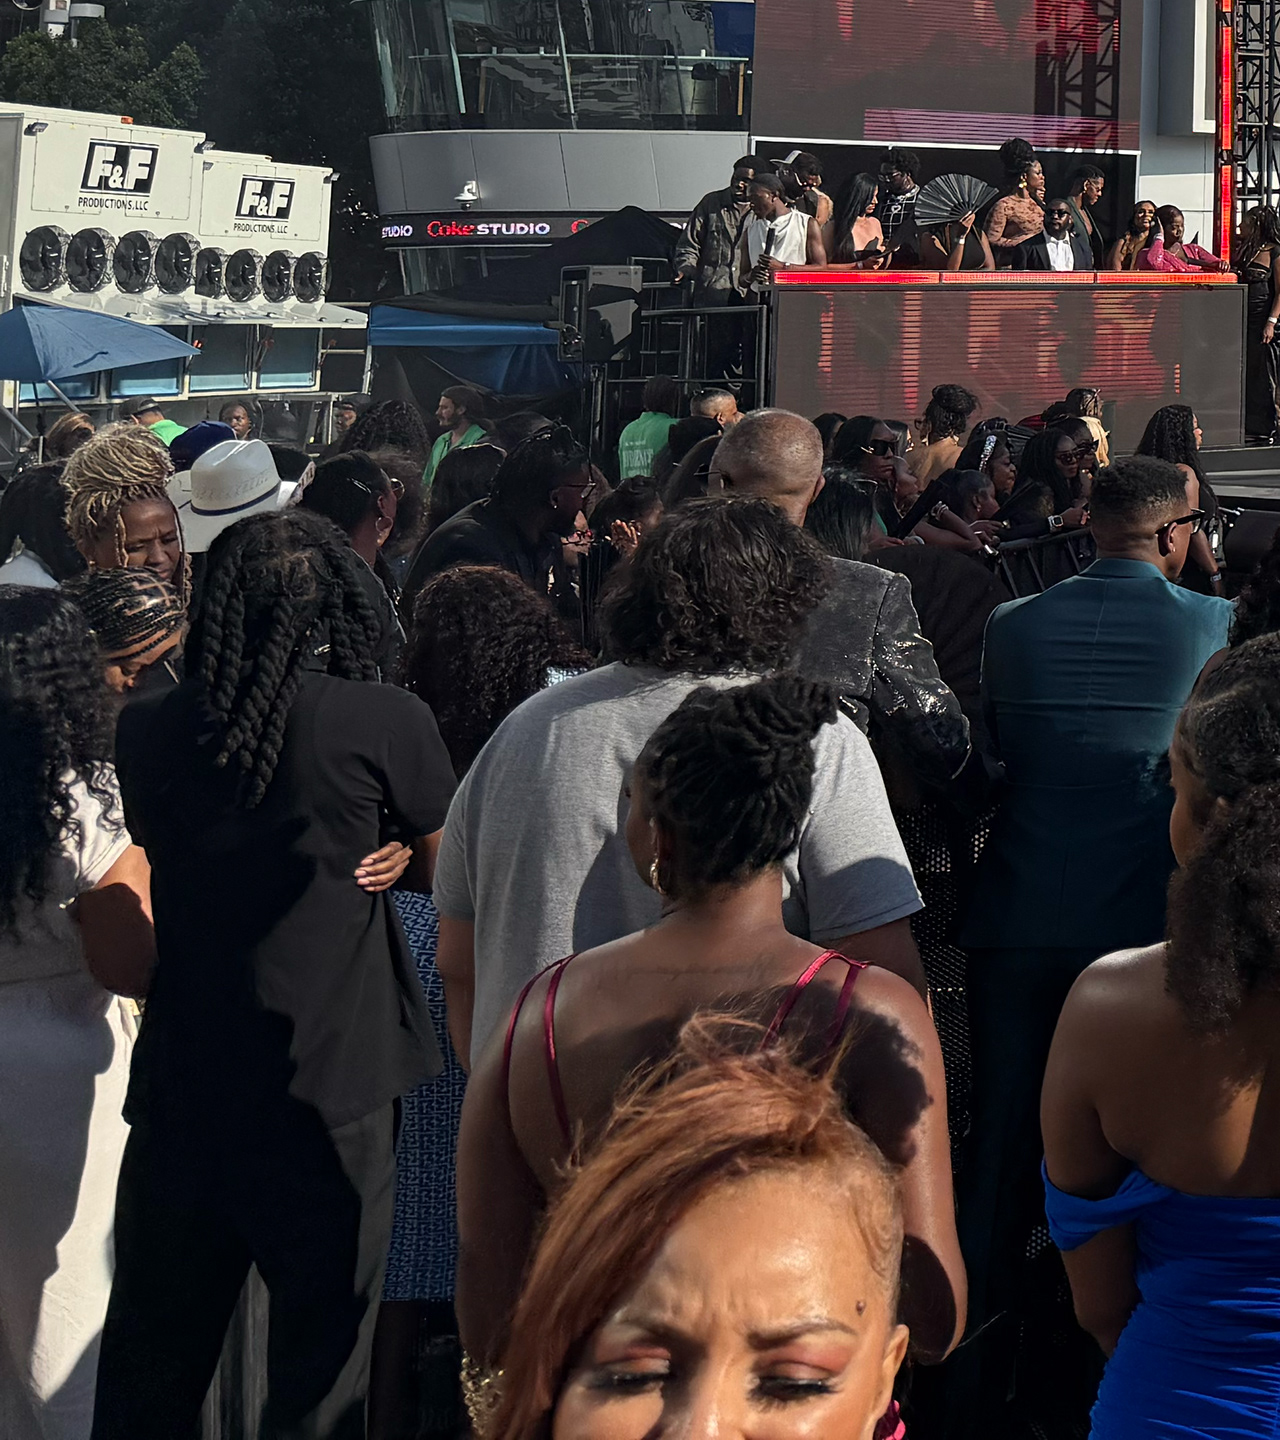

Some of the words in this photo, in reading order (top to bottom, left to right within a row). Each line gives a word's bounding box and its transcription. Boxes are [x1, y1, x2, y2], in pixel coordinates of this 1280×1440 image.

[87, 145, 153, 190] F&F
[240, 180, 291, 217] F&F
[427, 220, 474, 238] Coke
[476, 222, 551, 236] STUDIO
